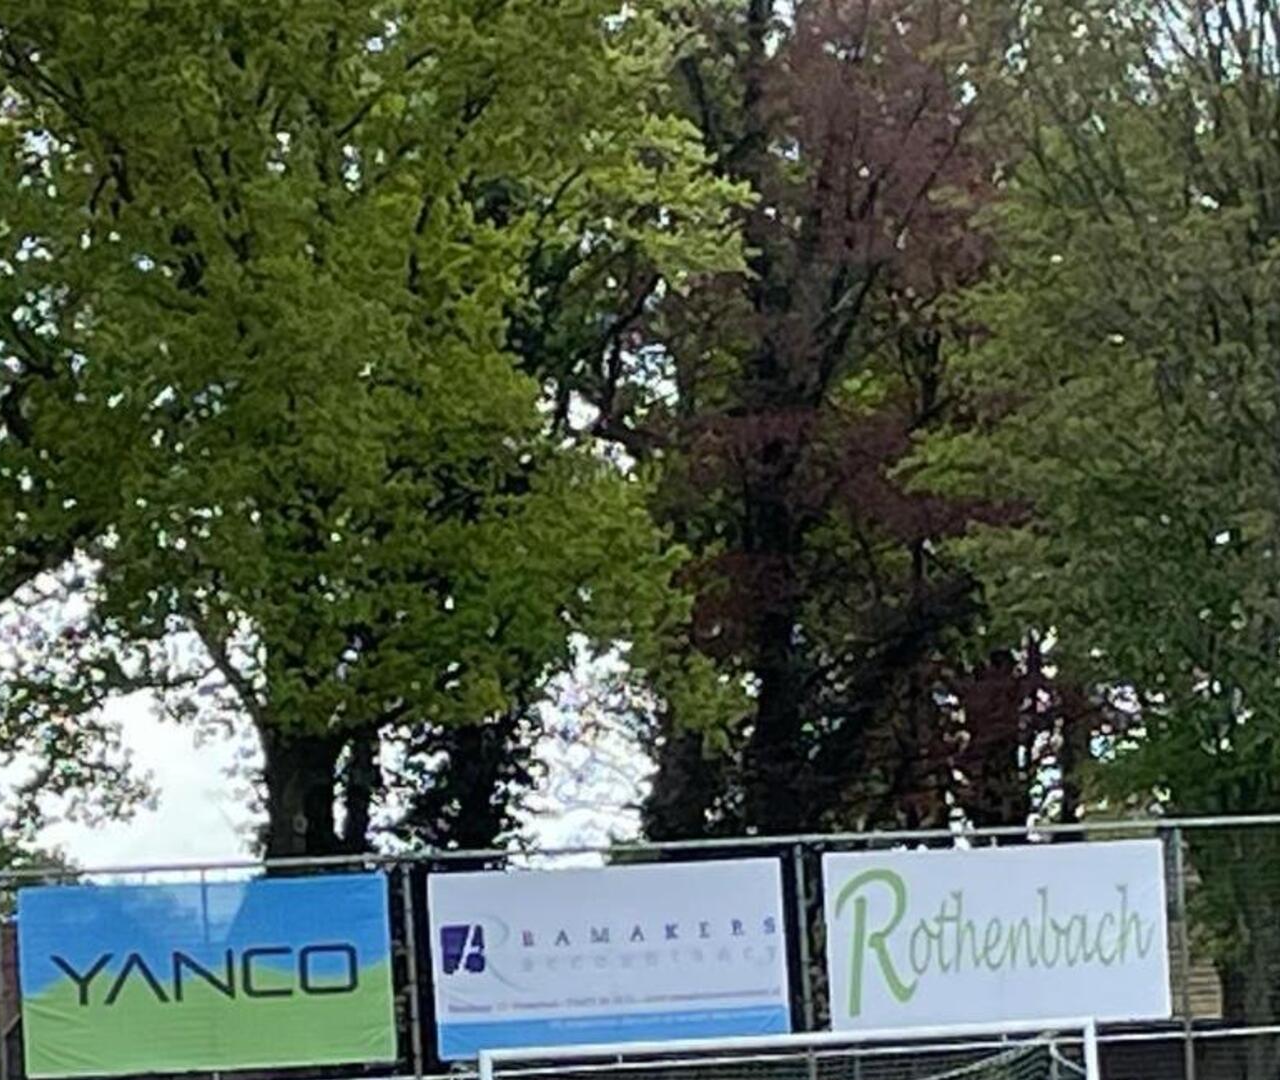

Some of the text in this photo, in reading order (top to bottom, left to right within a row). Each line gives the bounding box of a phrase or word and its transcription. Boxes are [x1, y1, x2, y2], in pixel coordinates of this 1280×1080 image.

[522, 916, 776, 947] RAMAKERS
[835, 868, 1155, 1018] Rothenbach
[49, 943, 358, 1006] YANCO
